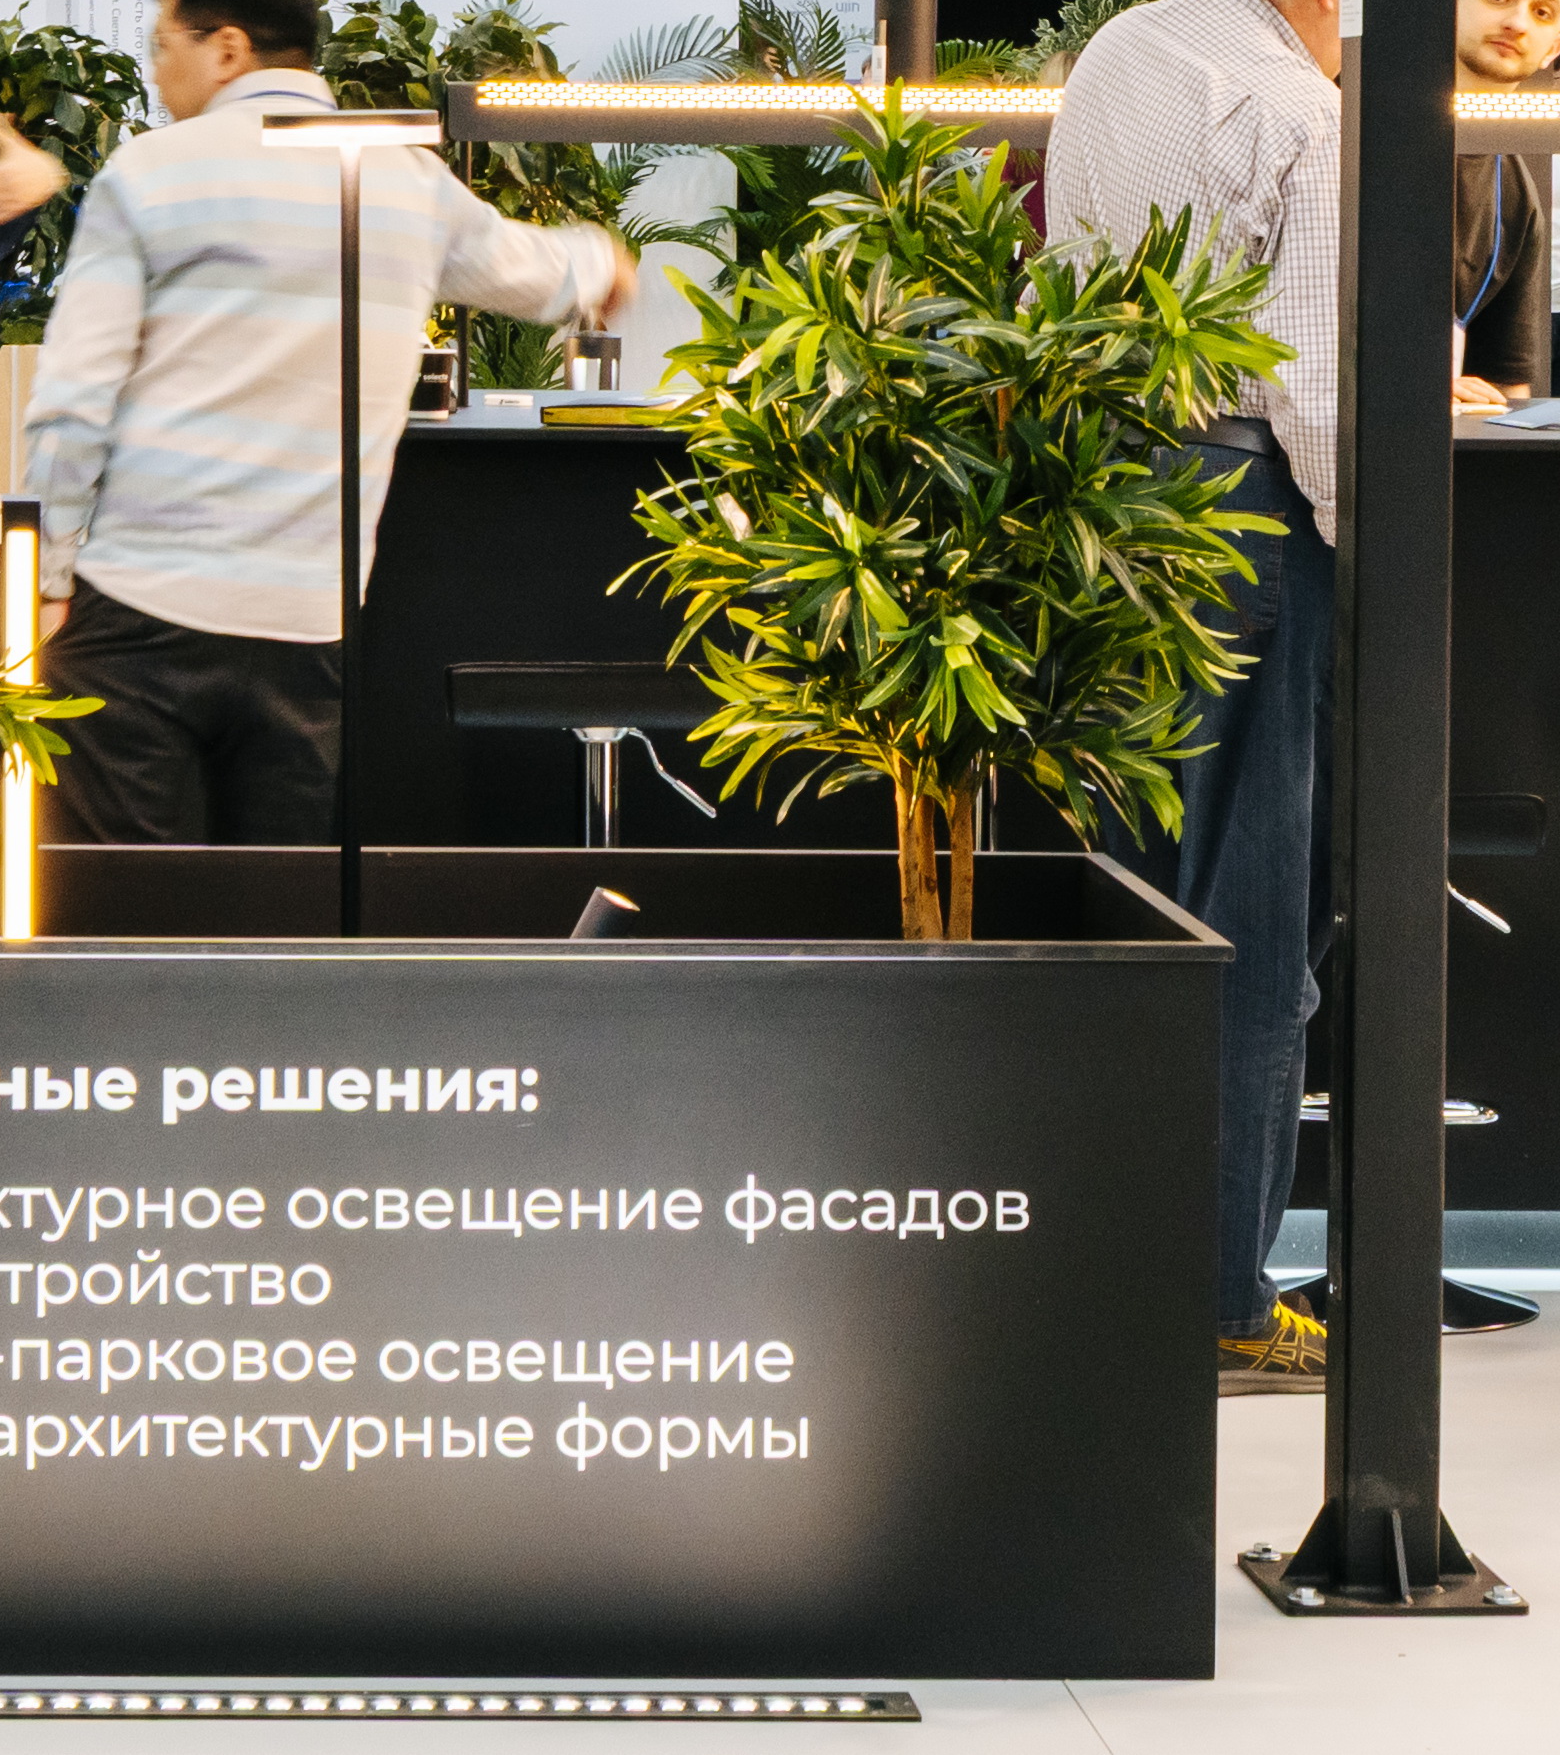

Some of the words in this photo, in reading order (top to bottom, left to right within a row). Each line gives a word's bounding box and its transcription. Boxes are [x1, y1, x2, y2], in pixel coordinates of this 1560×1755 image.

[162, 1066, 540, 1125] решения:
[287, 1186, 703, 1239] освещение
[724, 1174, 1029, 1244] фасадов
[378, 1339, 794, 1390] освещение
[555, 1400, 810, 1472] формы
